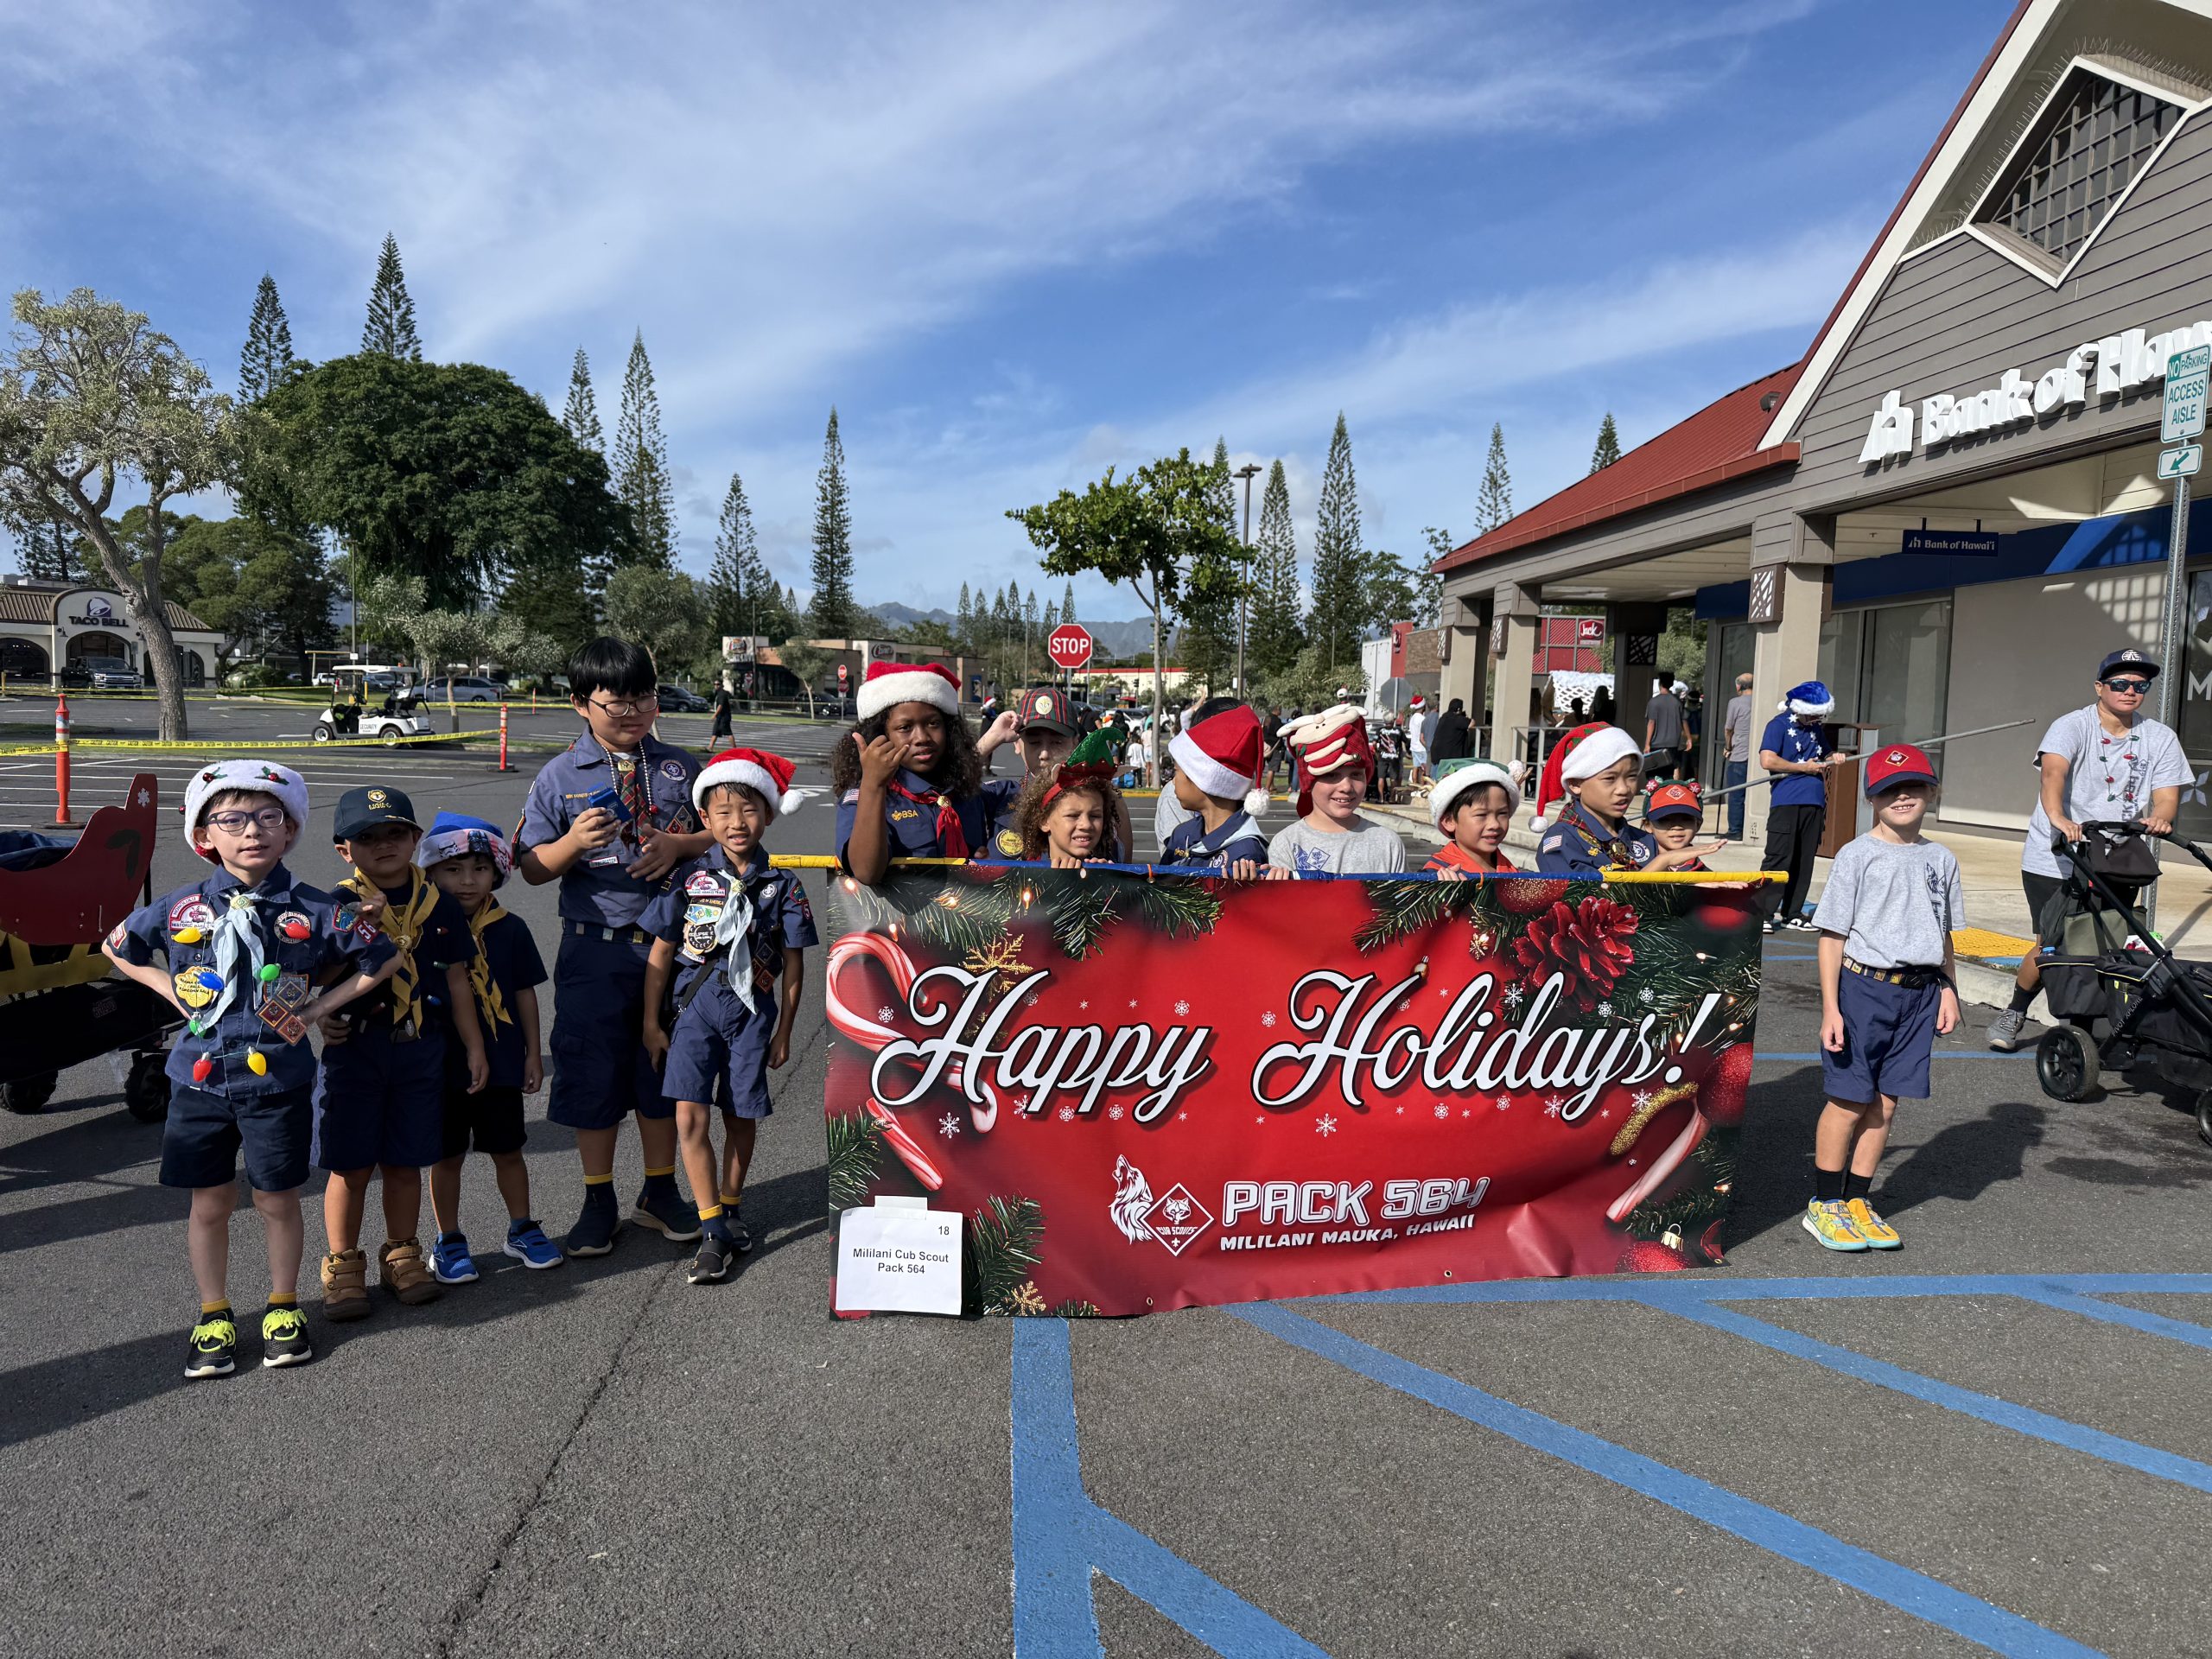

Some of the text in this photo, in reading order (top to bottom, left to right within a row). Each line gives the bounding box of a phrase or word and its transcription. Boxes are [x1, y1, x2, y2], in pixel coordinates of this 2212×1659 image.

[2168, 353, 2208, 378] NO PARKING
[1922, 369, 2034, 447] Bank
[2033, 343, 2100, 414] of
[2168, 378, 2204, 404] ACCESS
[2171, 404, 2197, 425] AISLE
[1924, 539, 1948, 549] Bank
[1949, 540, 1961, 550] of
[69, 615, 130, 627] TACO BELL
[1580, 621, 1602, 637] Jack
[1052, 637, 1089, 654] STOP
[901, 810, 918, 818] BSA
[358, 919, 377, 940] 56
[870, 964, 1723, 1123] Happy Holidays!
[1223, 1176, 1491, 1228] PACK 564
[938, 1225, 950, 1236] 18
[1155, 1226, 1198, 1236] CUB SCOUTS
[1220, 1213, 1476, 1251] MILILANI MAUKA, HAWAII
[853, 1248, 949, 1263] Mililani Cub Scout
[878, 1262, 925, 1274] Pack 564
